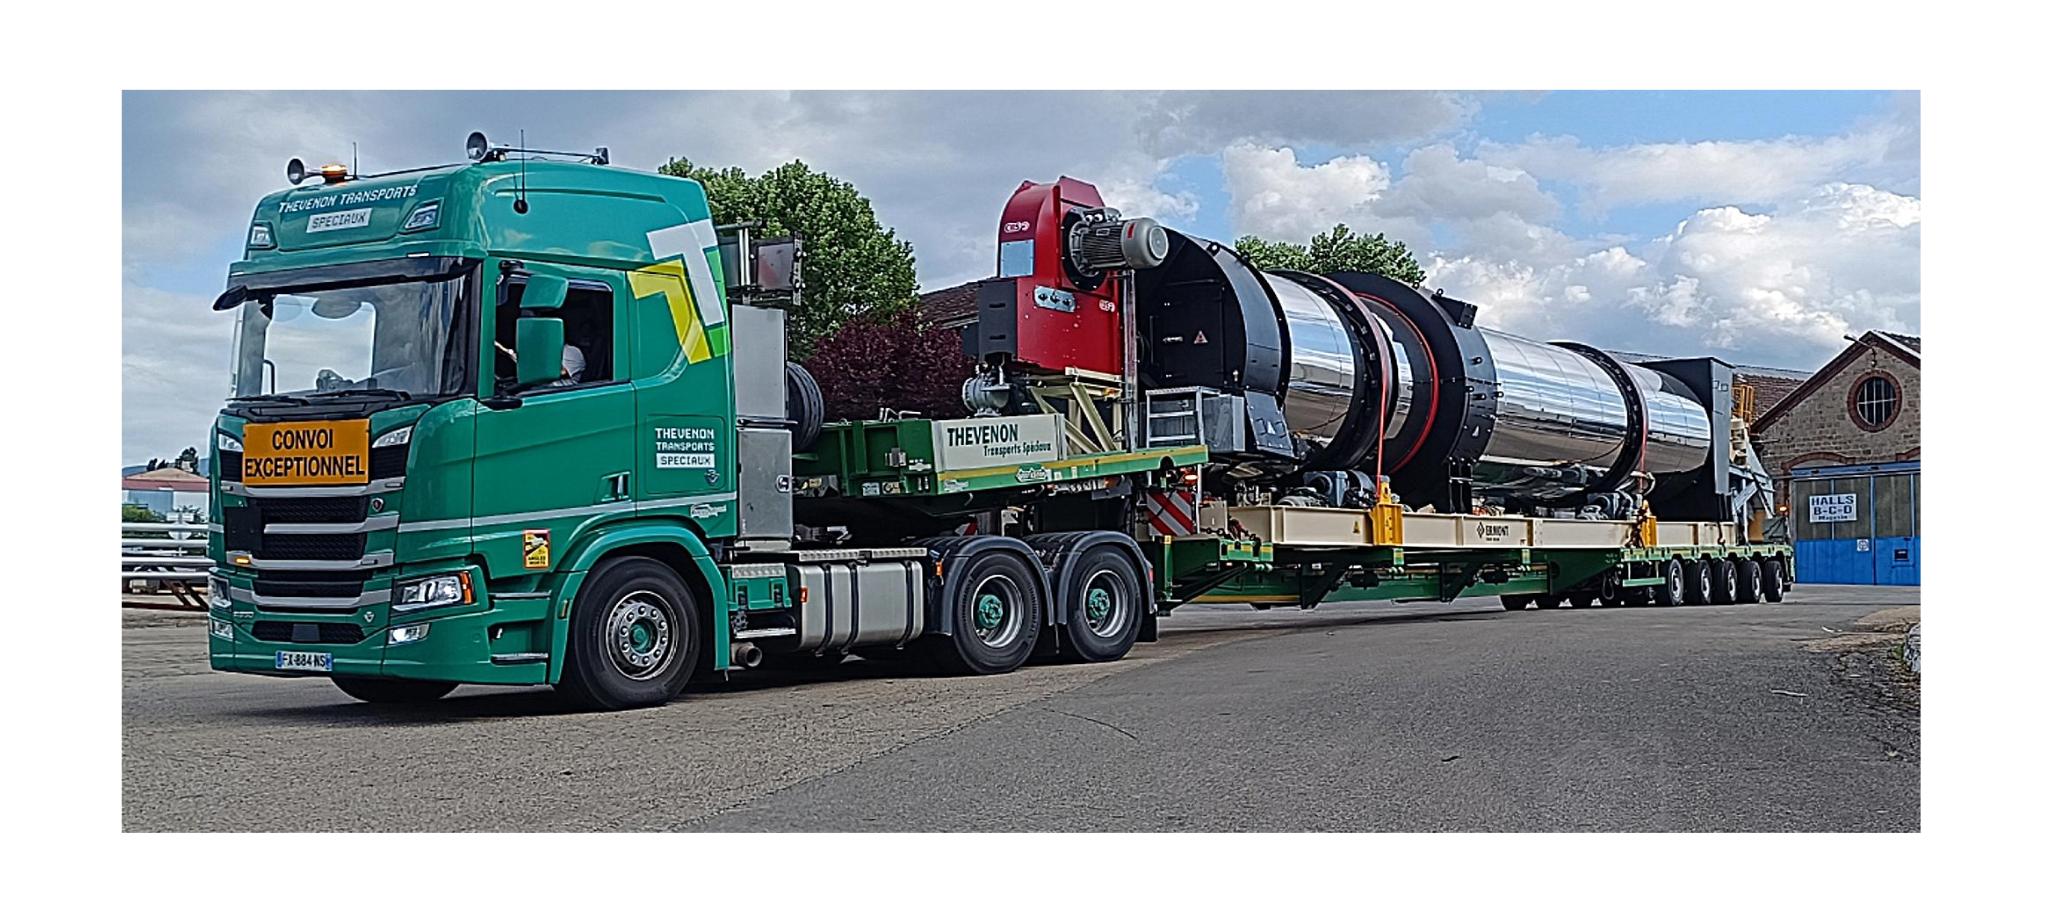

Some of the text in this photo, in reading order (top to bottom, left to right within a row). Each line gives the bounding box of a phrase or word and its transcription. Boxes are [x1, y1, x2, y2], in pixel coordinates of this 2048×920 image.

[279, 184, 419, 213] THEVENON TRANSPORTS
[311, 211, 367, 229] SPECIAUX
[272, 428, 334, 451] CONVOI
[655, 427, 715, 440] THEVENON
[946, 423, 1019, 447] THEVENON
[656, 441, 716, 452] TRANSPORTS
[984, 444, 1022, 459] Transports
[245, 454, 366, 479] EXCEPTIONNEL
[660, 455, 712, 466] SPECIAUX
[1811, 495, 1855, 506] HALLS
[1813, 505, 1853, 516] B-C-D
